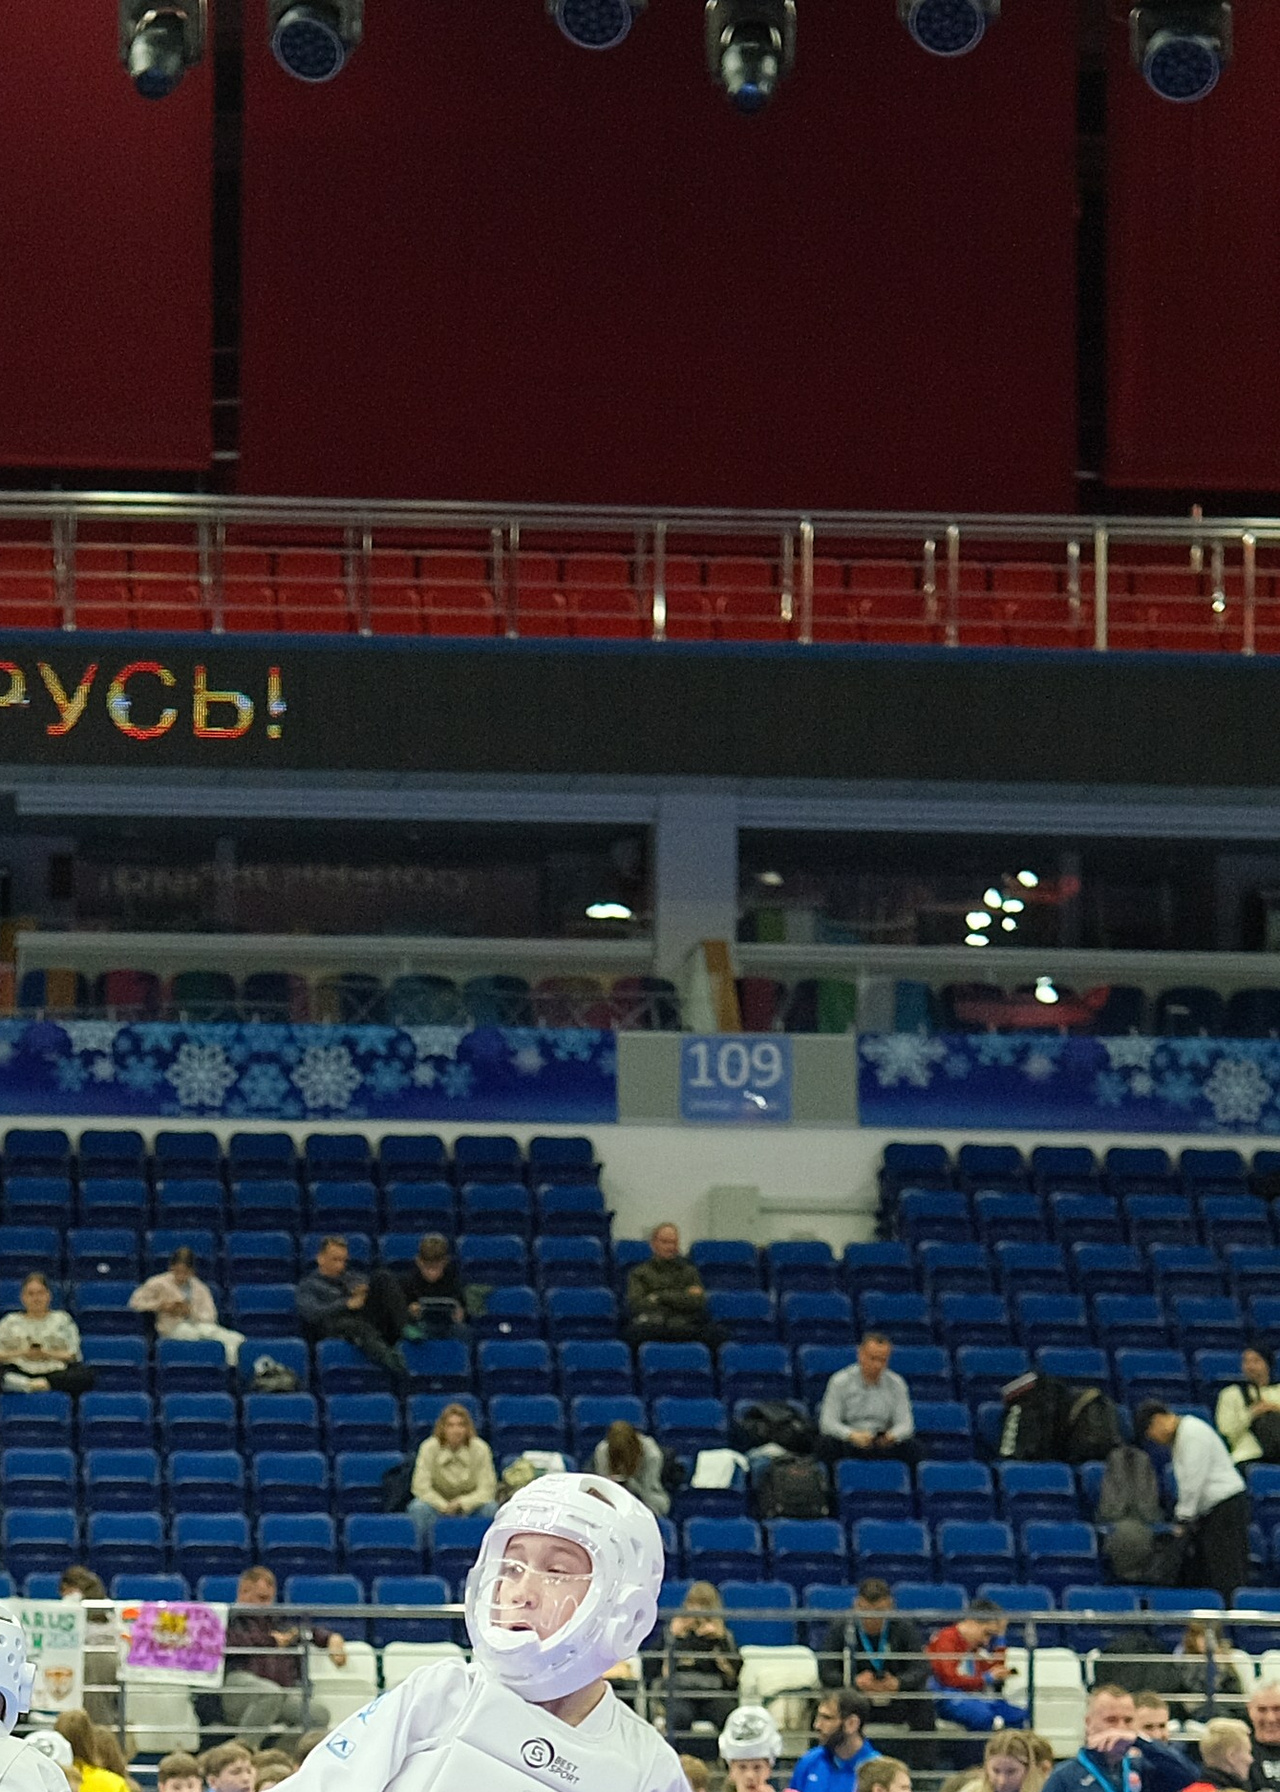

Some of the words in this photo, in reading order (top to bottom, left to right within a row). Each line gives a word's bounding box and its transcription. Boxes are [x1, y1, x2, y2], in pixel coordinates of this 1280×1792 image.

[688, 1041, 782, 1088] 109
[548, 1764, 579, 1784] SPORT
[555, 1756, 578, 1772] BEST
